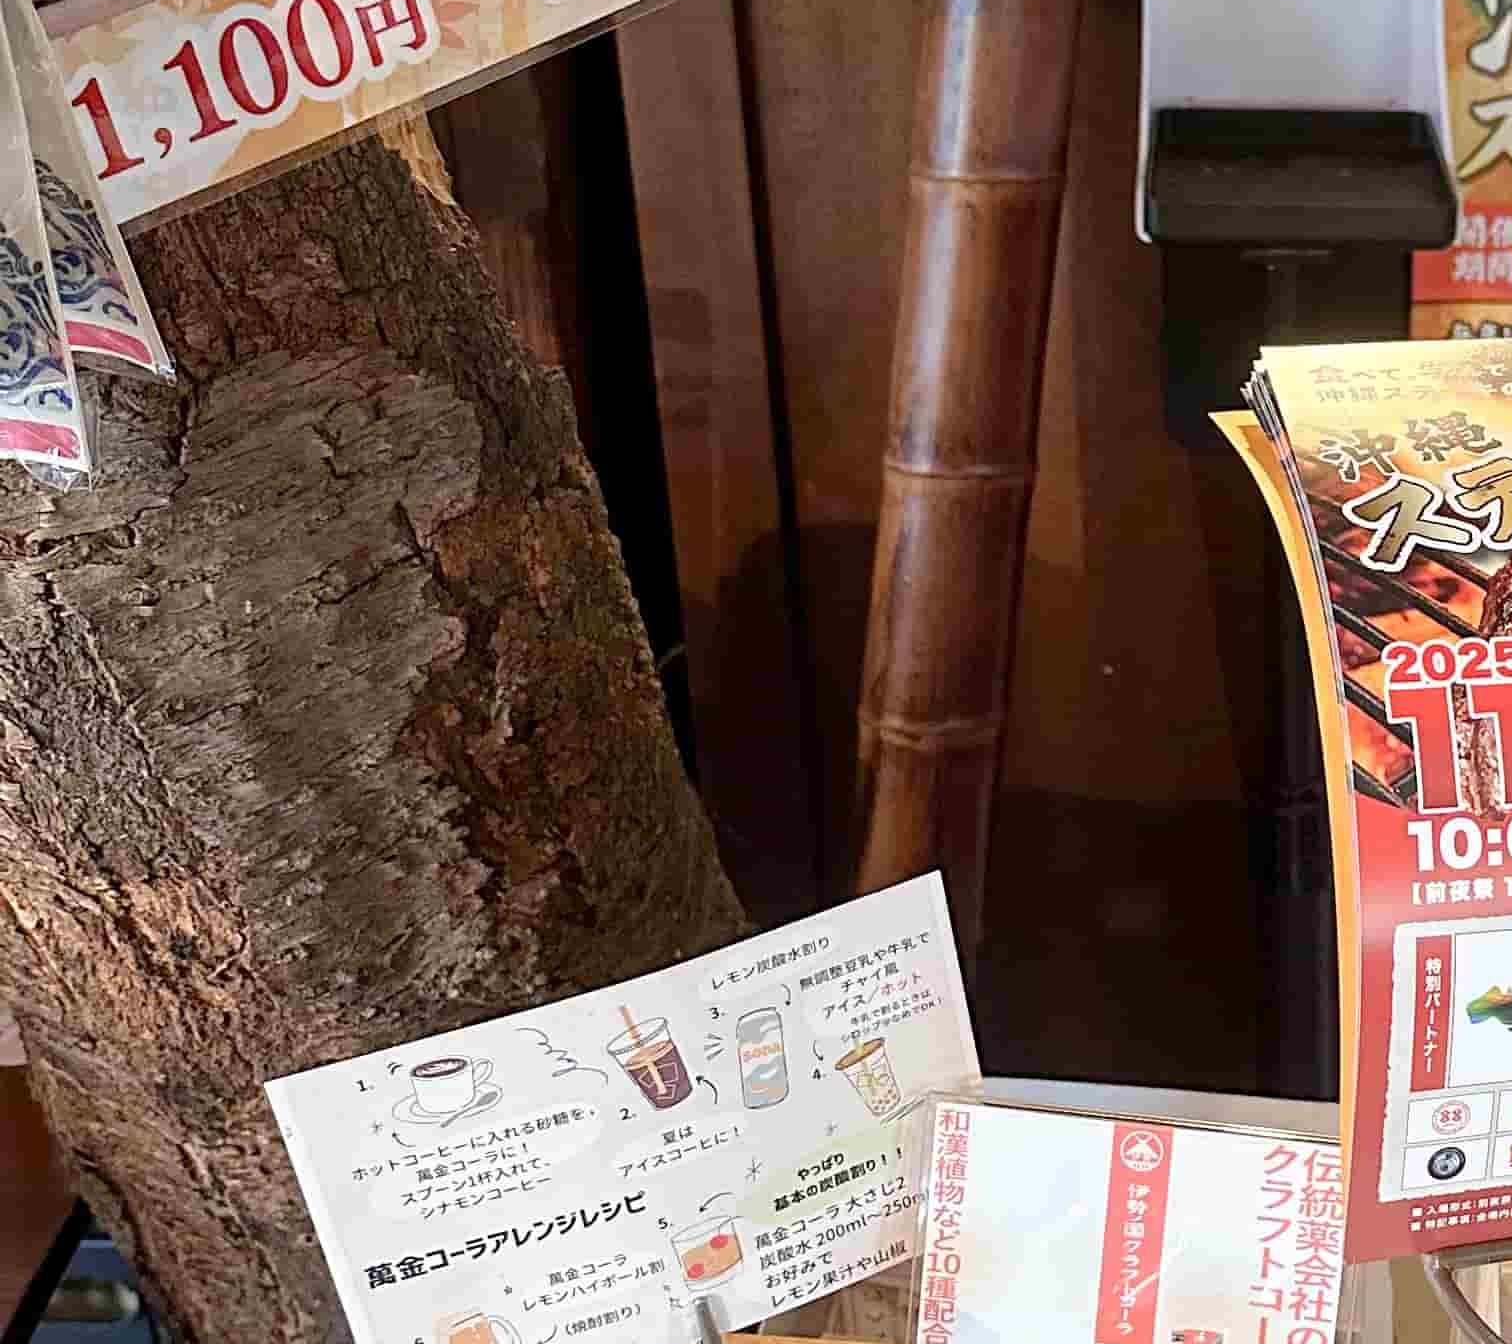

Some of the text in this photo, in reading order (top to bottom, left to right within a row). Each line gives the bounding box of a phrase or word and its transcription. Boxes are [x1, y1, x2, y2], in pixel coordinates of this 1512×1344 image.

[797, 1152, 845, 1181] やっぱり
[420, 1176, 553, 1220] シナモンコーヒー
[363, 1190, 648, 1289] 萬金コーラアレンジレシピ
